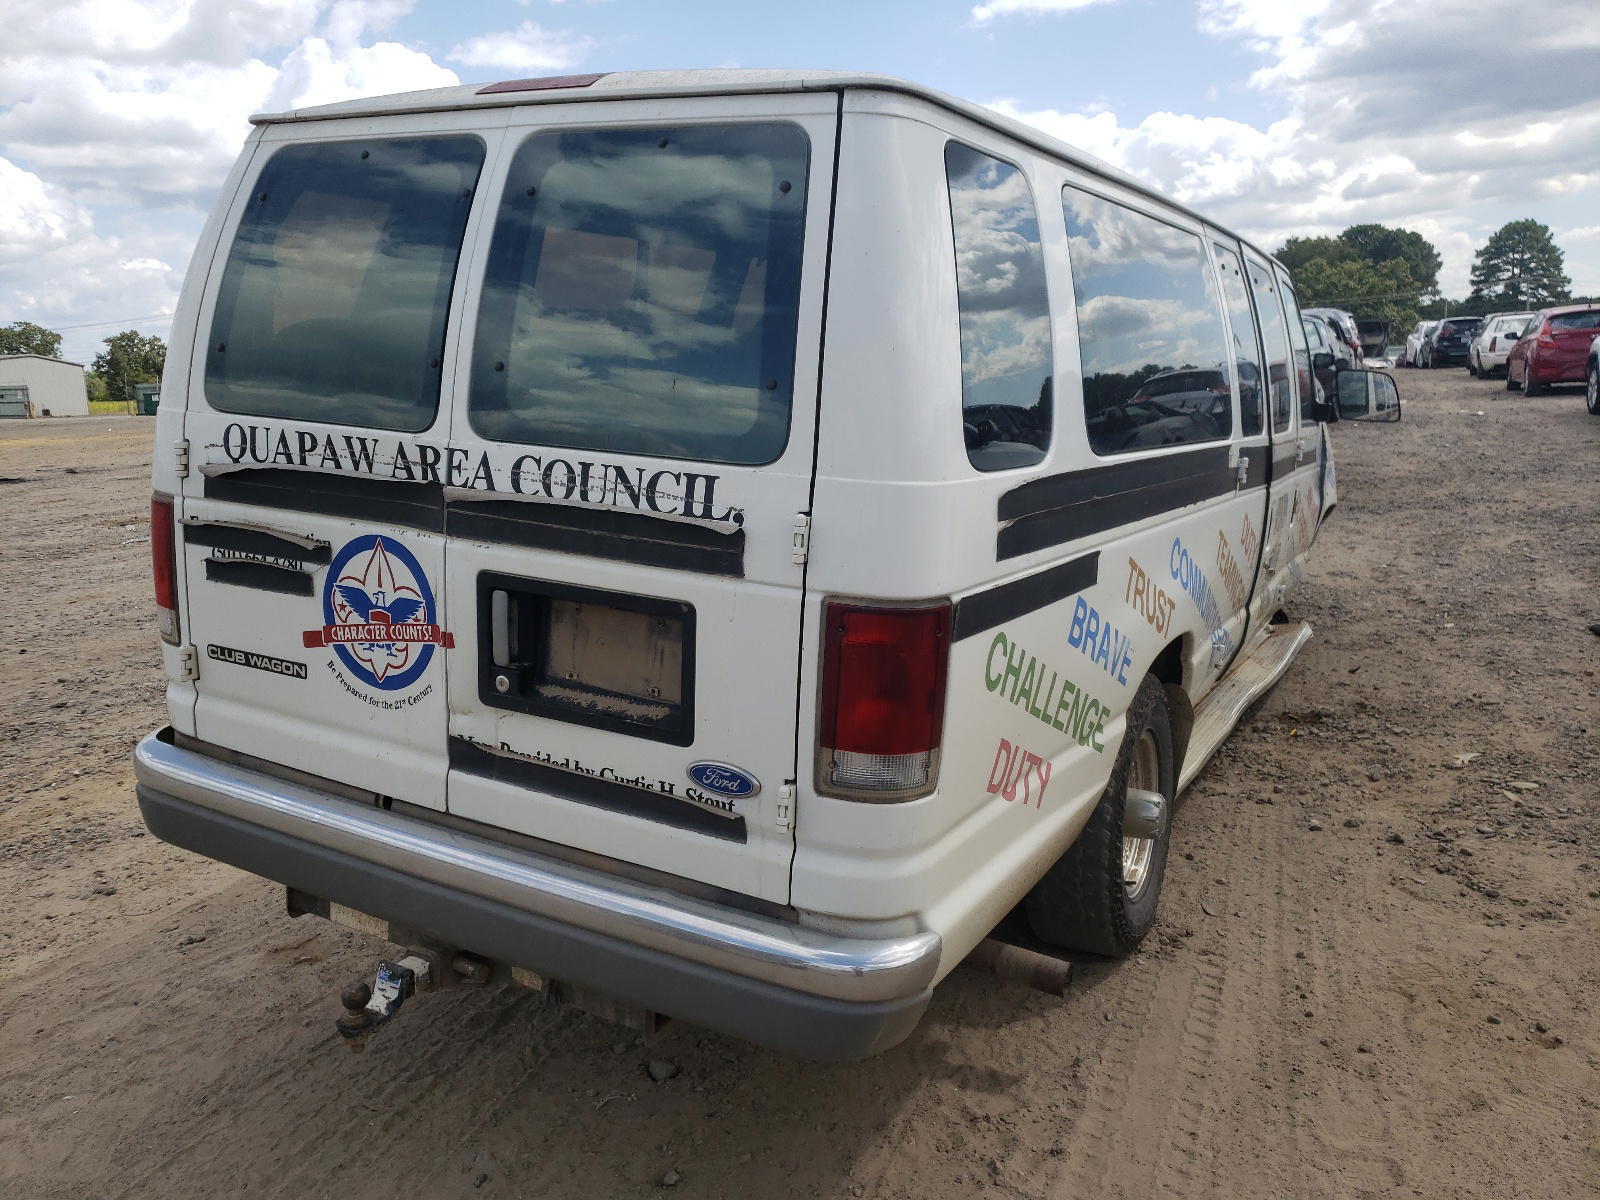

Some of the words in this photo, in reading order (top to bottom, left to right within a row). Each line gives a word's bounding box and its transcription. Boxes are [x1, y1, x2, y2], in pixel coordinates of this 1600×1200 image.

[222, 423, 379, 473] QUAPAW
[391, 441, 496, 491] AREA
[1125, 556, 1176, 640] TRUST
[207, 645, 246, 664] CLUB
[248, 654, 307, 678] WAGON
[331, 624, 388, 641] CHARACTER
[389, 624, 433, 641] COUNTS!
[1067, 594, 1134, 687] BRAVE
[326, 660, 337, 674] Be
[335, 671, 368, 702] Prepared
[368, 697, 381, 708] for
[381, 700, 394, 710] the
[407, 683, 433, 706] Century
[984, 632, 1111, 754] CHALLENGE
[702, 767, 741, 791] Ford
[986, 737, 1053, 809] DUTY
